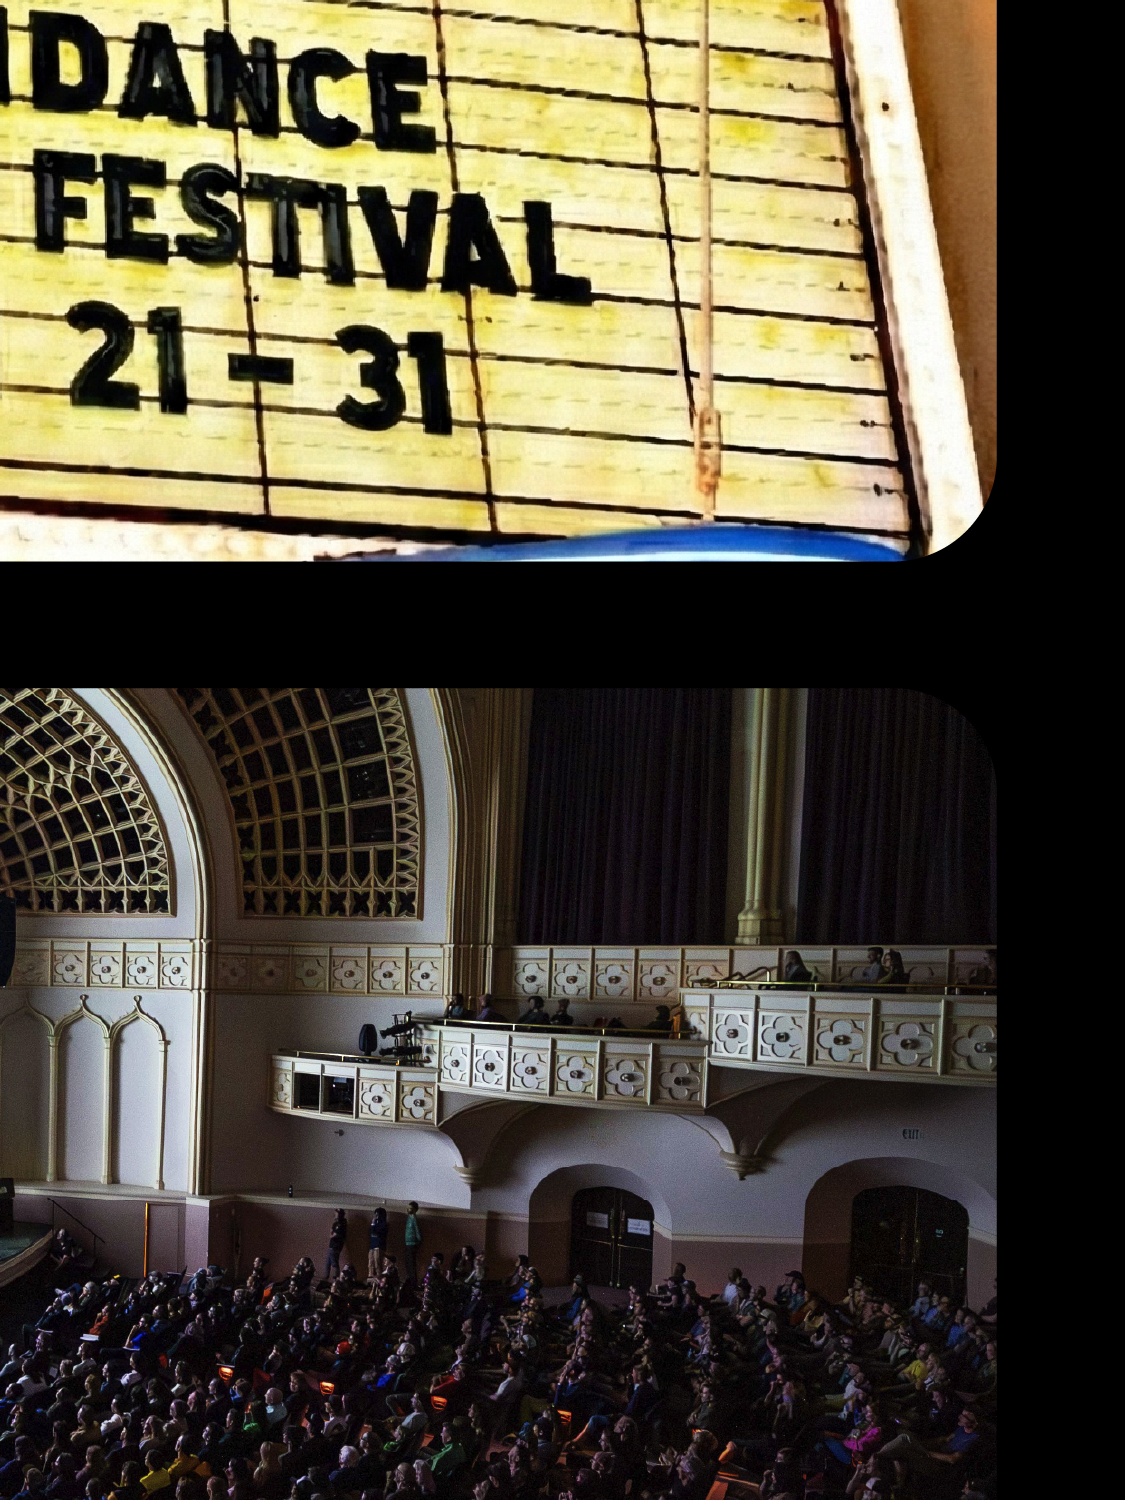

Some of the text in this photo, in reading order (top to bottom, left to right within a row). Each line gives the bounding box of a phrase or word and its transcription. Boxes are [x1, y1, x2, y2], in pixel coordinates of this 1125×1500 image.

[33, 150, 593, 306] FESTIVAL
[67, 300, 189, 416] 21
[336, 324, 454, 436] 31
